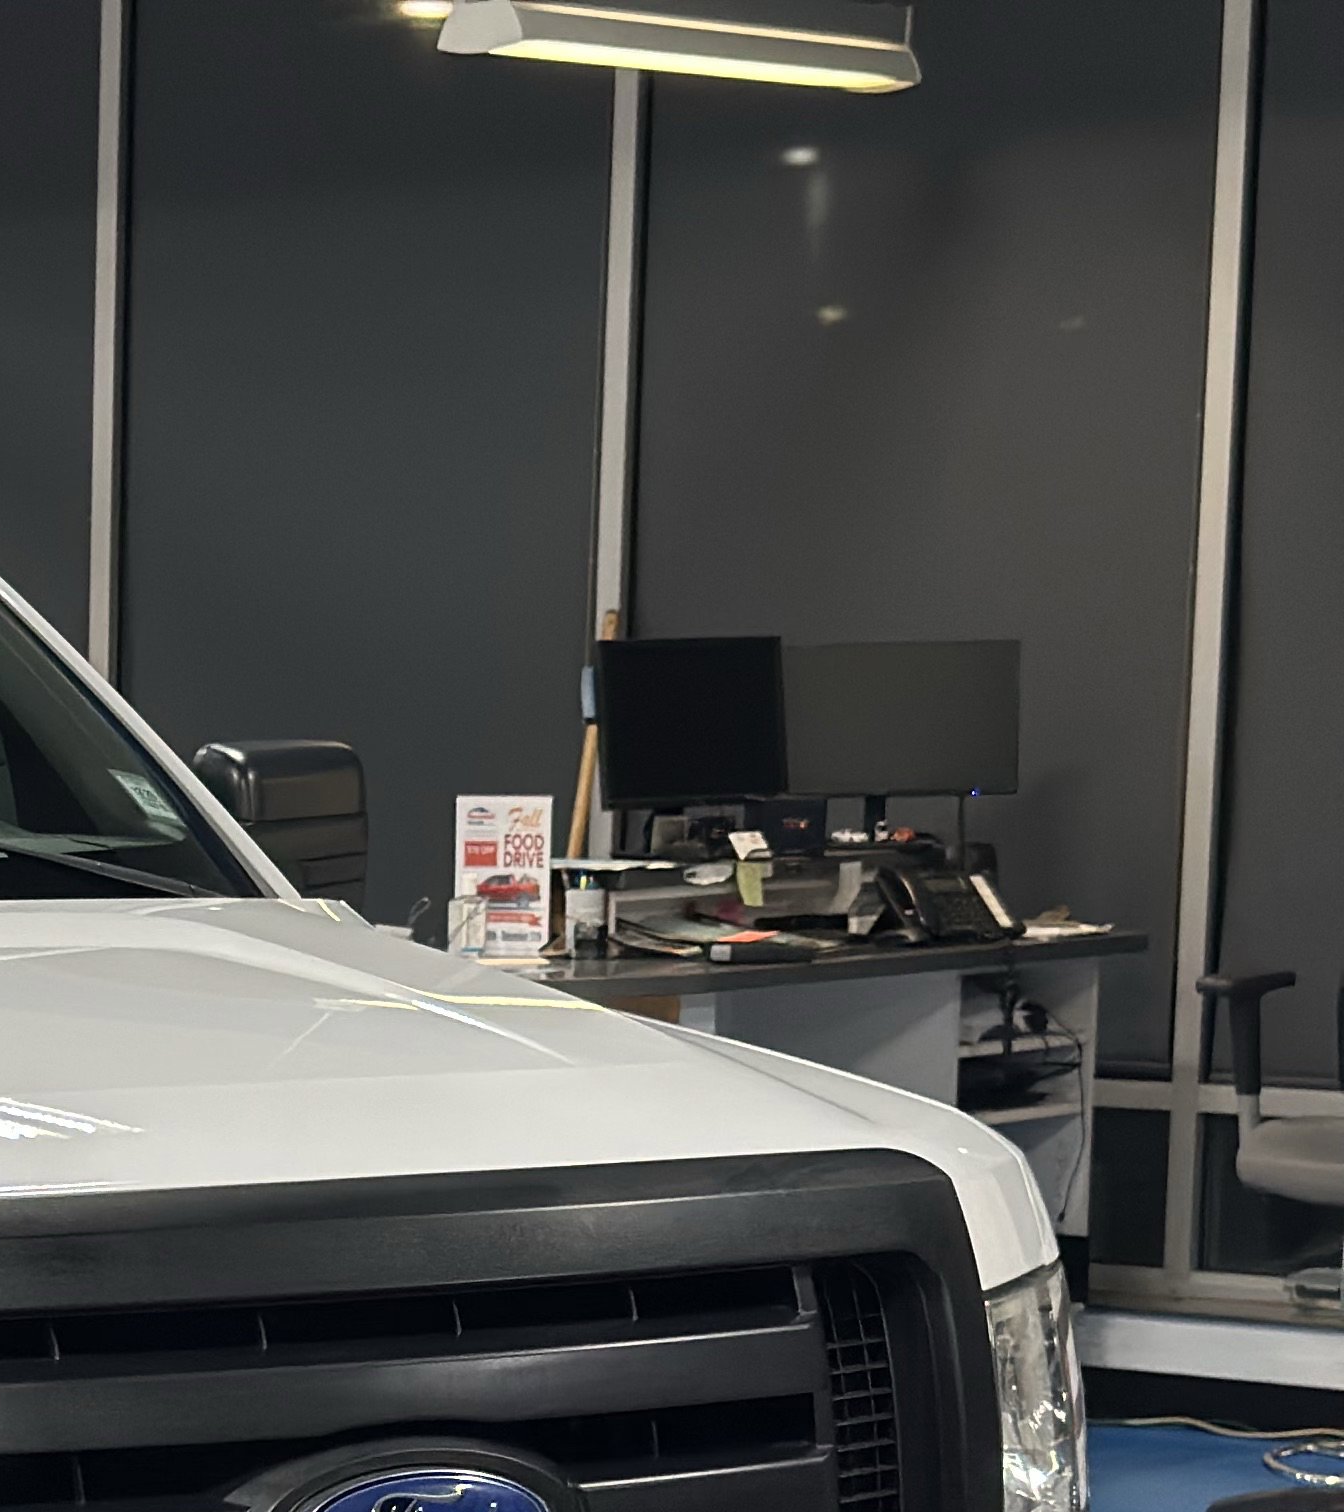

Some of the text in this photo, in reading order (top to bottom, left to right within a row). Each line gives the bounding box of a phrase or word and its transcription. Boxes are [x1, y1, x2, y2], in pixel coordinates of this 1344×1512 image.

[508, 807, 543, 831] Fall
[504, 834, 545, 850] FOOD
[503, 851, 544, 869] DRIVE
